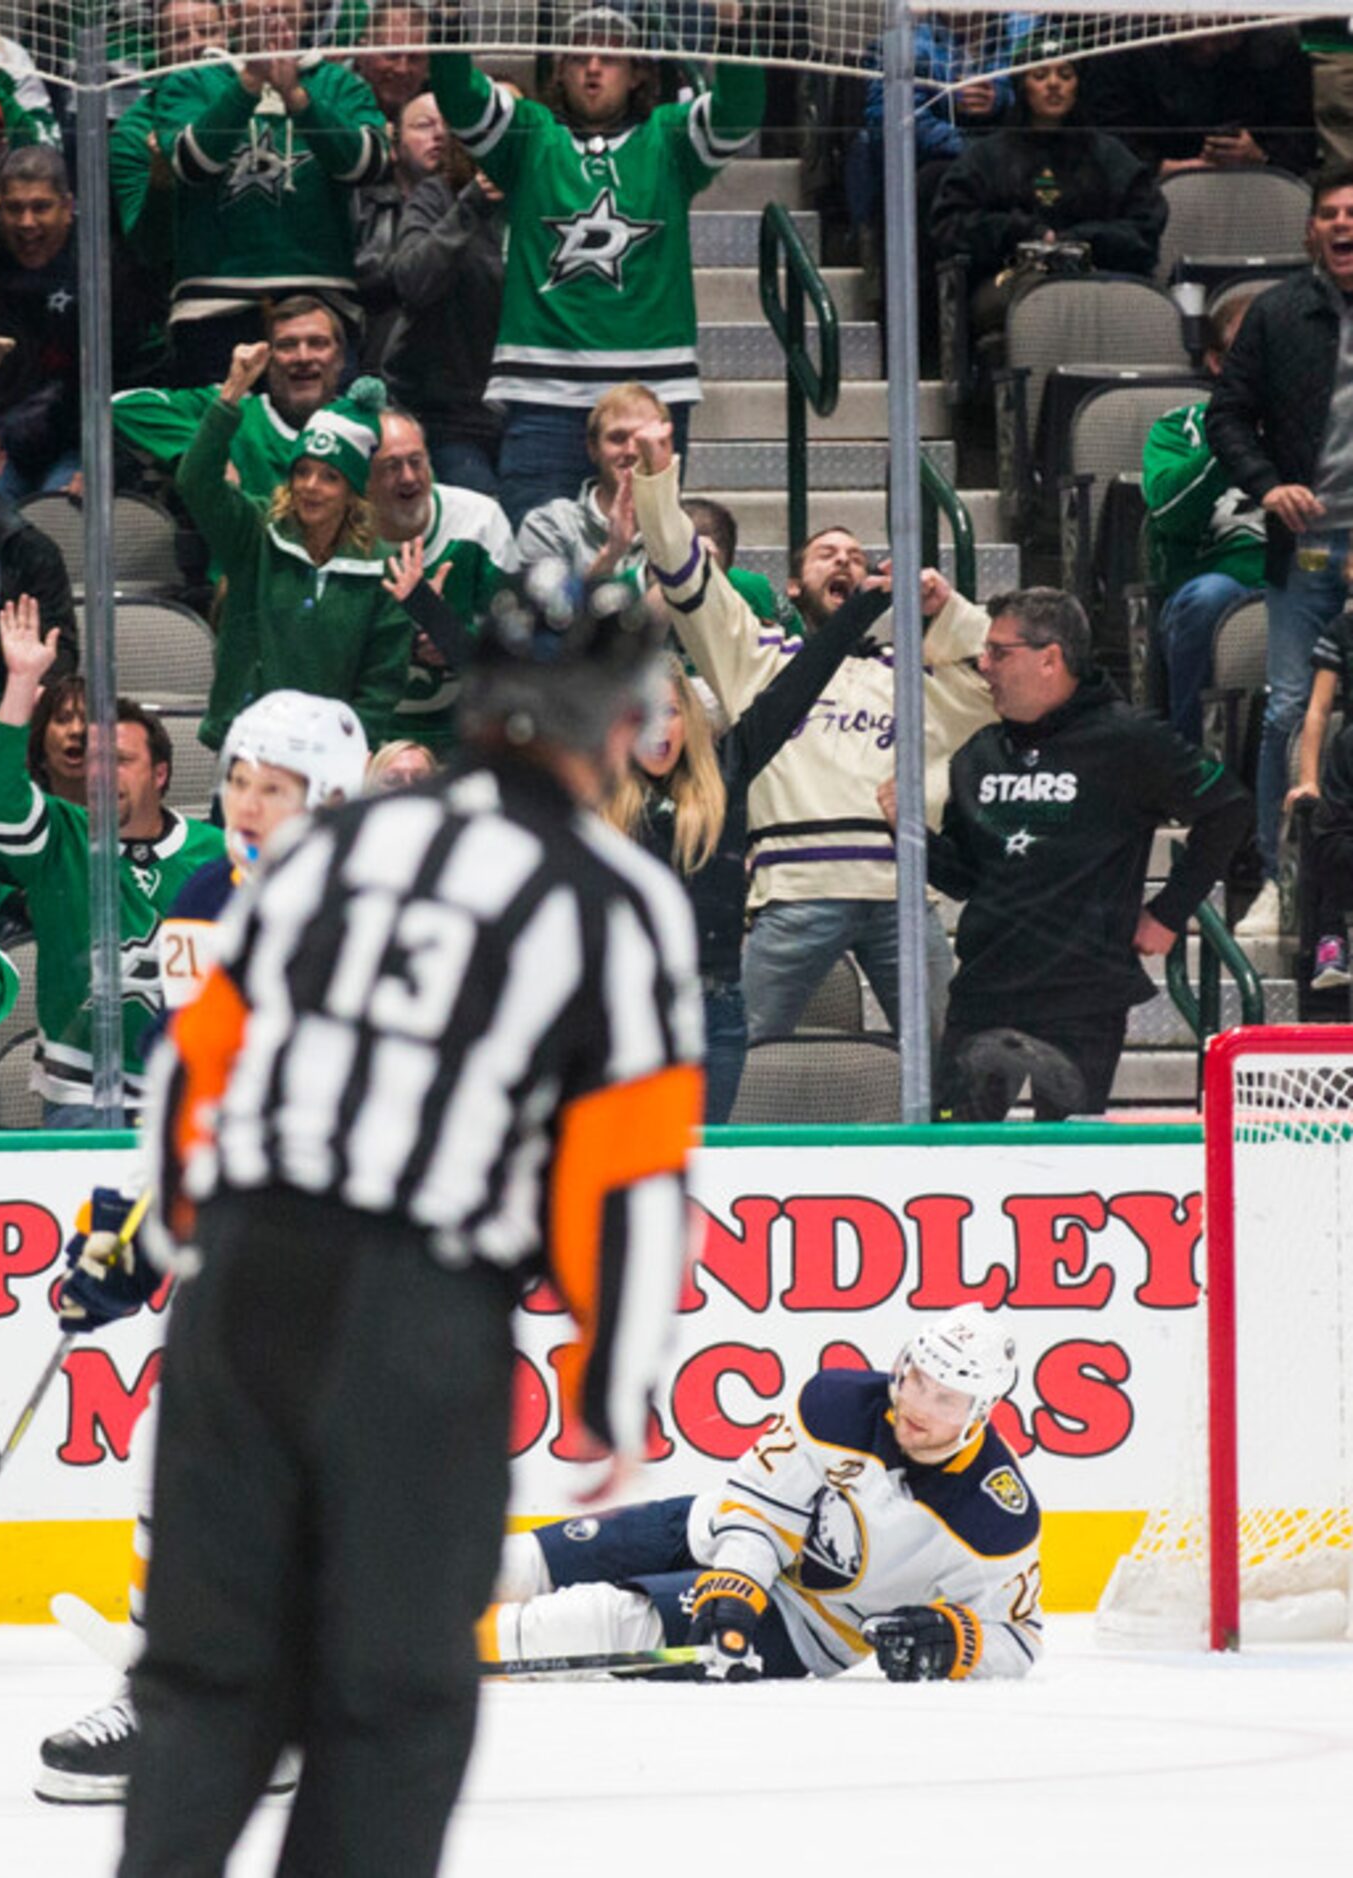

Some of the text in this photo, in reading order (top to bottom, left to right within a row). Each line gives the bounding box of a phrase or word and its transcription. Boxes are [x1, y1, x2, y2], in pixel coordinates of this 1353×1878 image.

[978, 772, 1078, 803] STARS
[164, 933, 202, 978] 21
[326, 892, 476, 1039] 13
